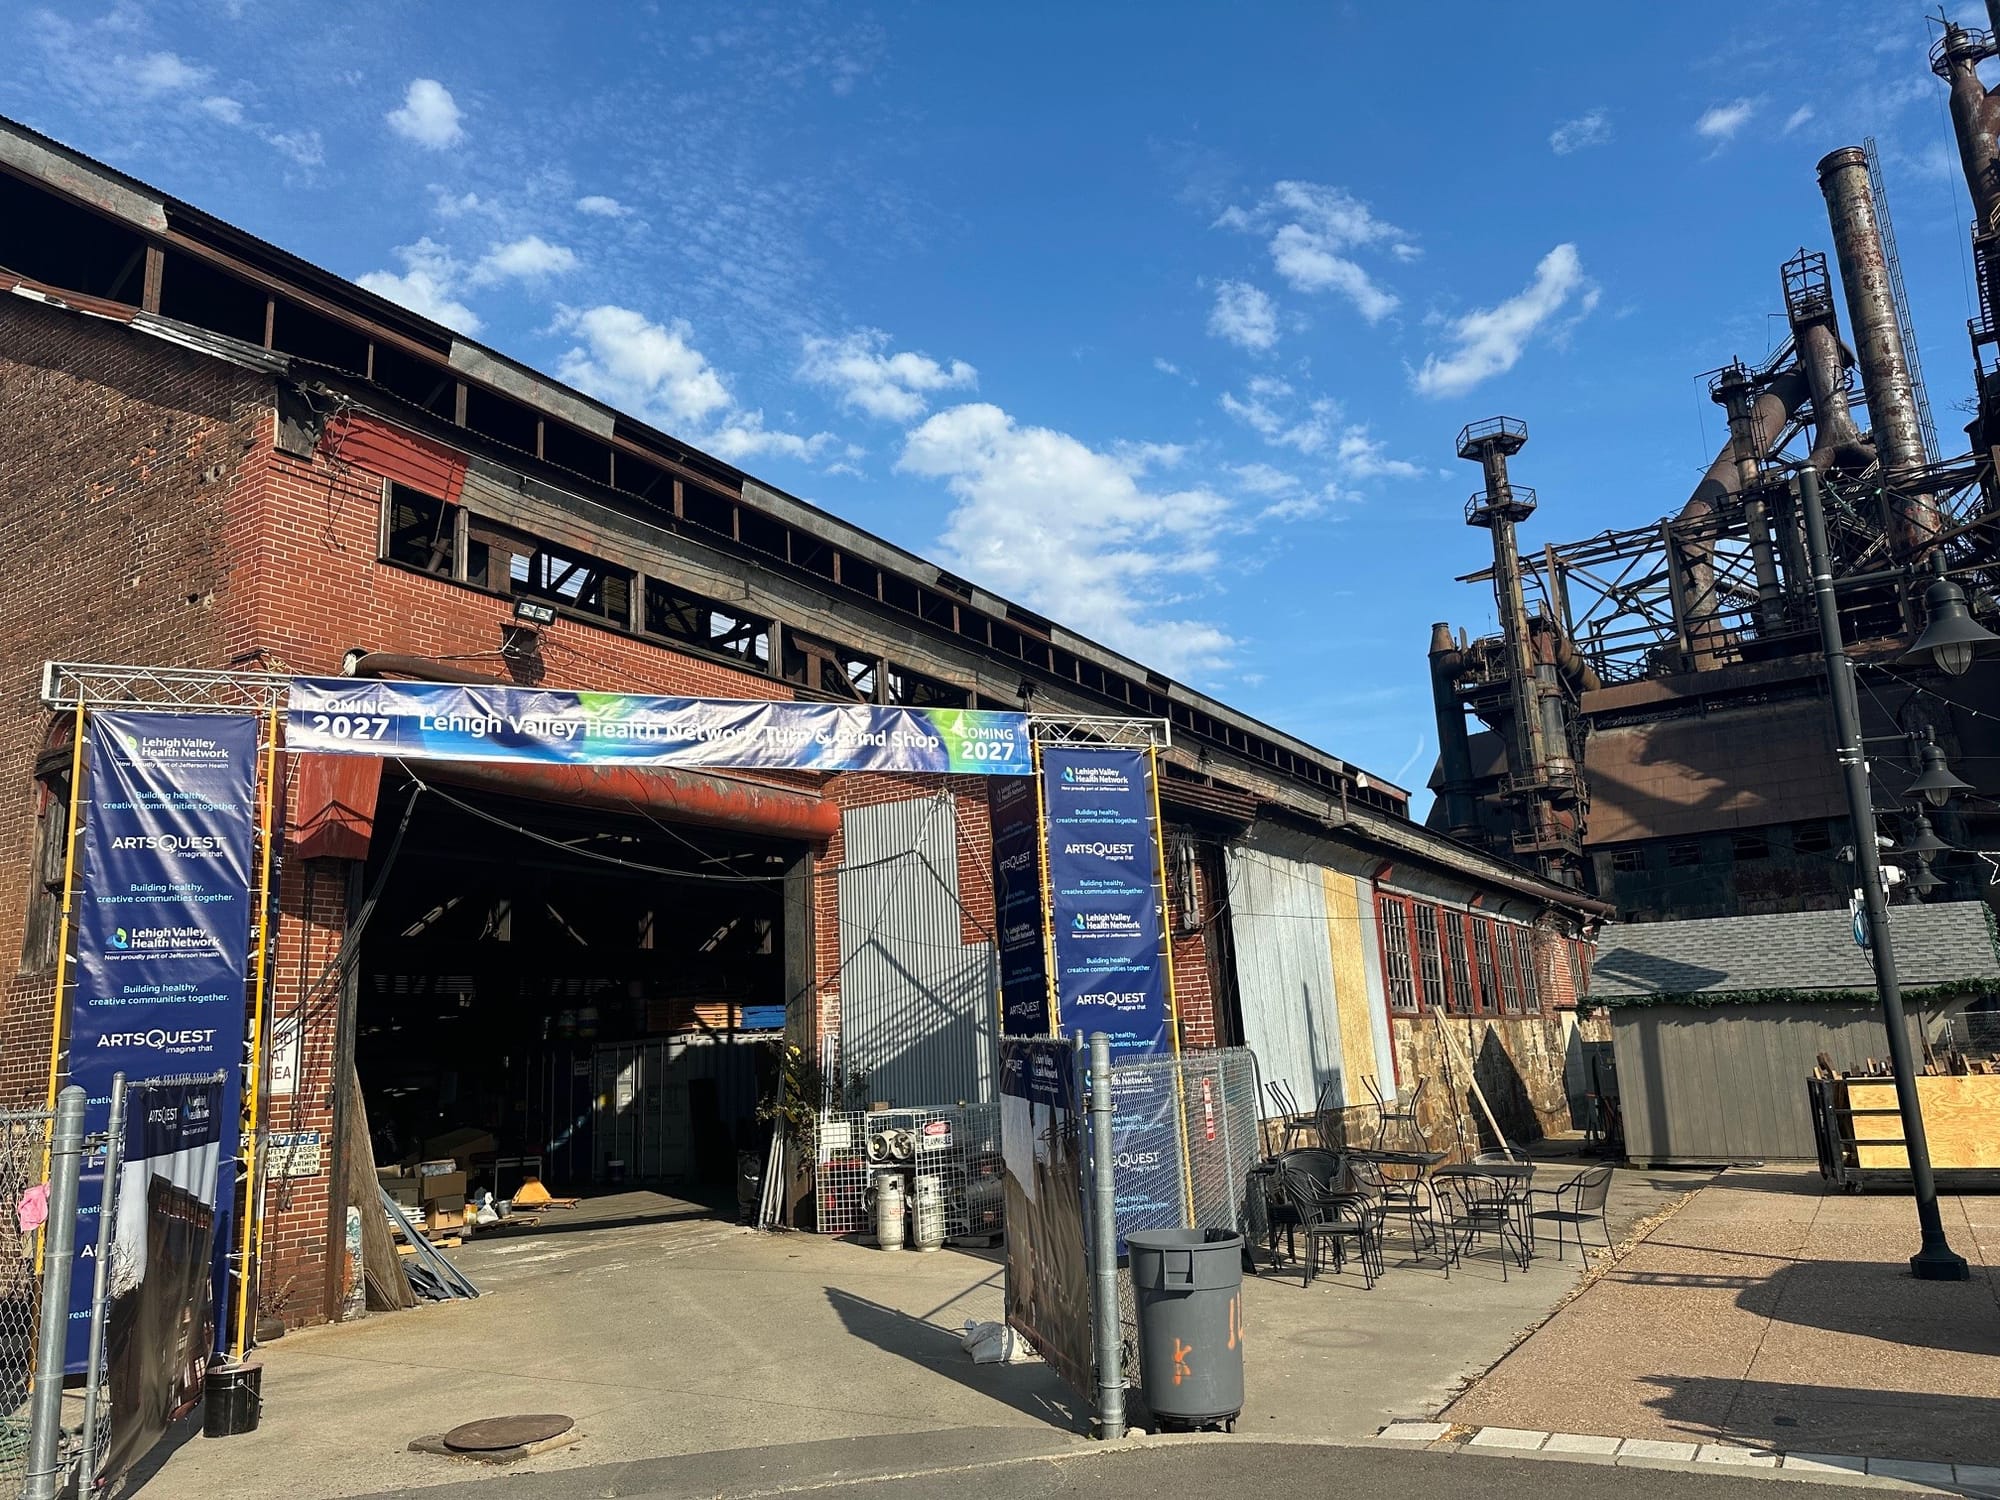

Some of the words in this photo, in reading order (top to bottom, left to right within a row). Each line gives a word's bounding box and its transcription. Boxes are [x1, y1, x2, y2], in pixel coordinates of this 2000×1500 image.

[312, 716, 390, 740] 2027
[419, 714, 502, 738] Lehigh
[510, 716, 578, 741] Valley
[586, 722, 660, 740] Health
[666, 724, 758, 742] Network
[815, 728, 832, 745] &
[892, 730, 939, 752] Shop
[962, 727, 1014, 741] COMING
[142, 736, 181, 749] Lehigh
[182, 738, 216, 750] Valley
[142, 747, 180, 757] Health
[181, 748, 229, 758] Network
[961, 741, 1015, 761] 2027
[1075, 768, 1099, 777] Lehigh
[1099, 768, 1120, 777] Valley
[1099, 776, 1129, 784] Network
[136, 792, 171, 800] Building
[173, 792, 209, 801] healthy,
[103, 801, 138, 809] creative
[140, 801, 197, 810] communities
[199, 802, 239, 811] together.
[112, 834, 224, 854] ARTSQUEST
[1065, 842, 1135, 857] ARTSQUEST
[178, 851, 207, 859] imagine
[208, 850, 223, 858] that
[1000, 850, 1030, 872] RTSQUEST
[131, 884, 167, 893] Building
[169, 884, 204, 892] healthy,
[96, 895, 133, 903] creative
[135, 895, 193, 903] communities
[194, 894, 235, 903] together.
[1110, 914, 1131, 922] Valley
[1086, 921, 1110, 930] Health
[1111, 921, 1140, 929] Network
[132, 928, 171, 939] Lehigh
[172, 927, 206, 939] Valley
[132, 937, 169, 948] Health
[172, 937, 220, 947] Network
[124, 985, 160, 994] Building
[162, 984, 198, 992] healthy,
[89, 997, 126, 1006] creative
[128, 996, 186, 1005] communities
[188, 994, 230, 1003] together.
[1076, 992, 1147, 1007] ARTSQUEST
[97, 1030, 215, 1050] ARTSQUEST
[1132, 1040, 1158, 1048] together.
[166, 1046, 196, 1055] imagine
[85, 1096, 113, 1105] reativ
[282, 1160, 320, 1169] DPARTMENT
[1113, 1152, 1160, 1169] SQUEST
[78, 1205, 101, 1215] reati
[69, 1309, 92, 1320] reati
